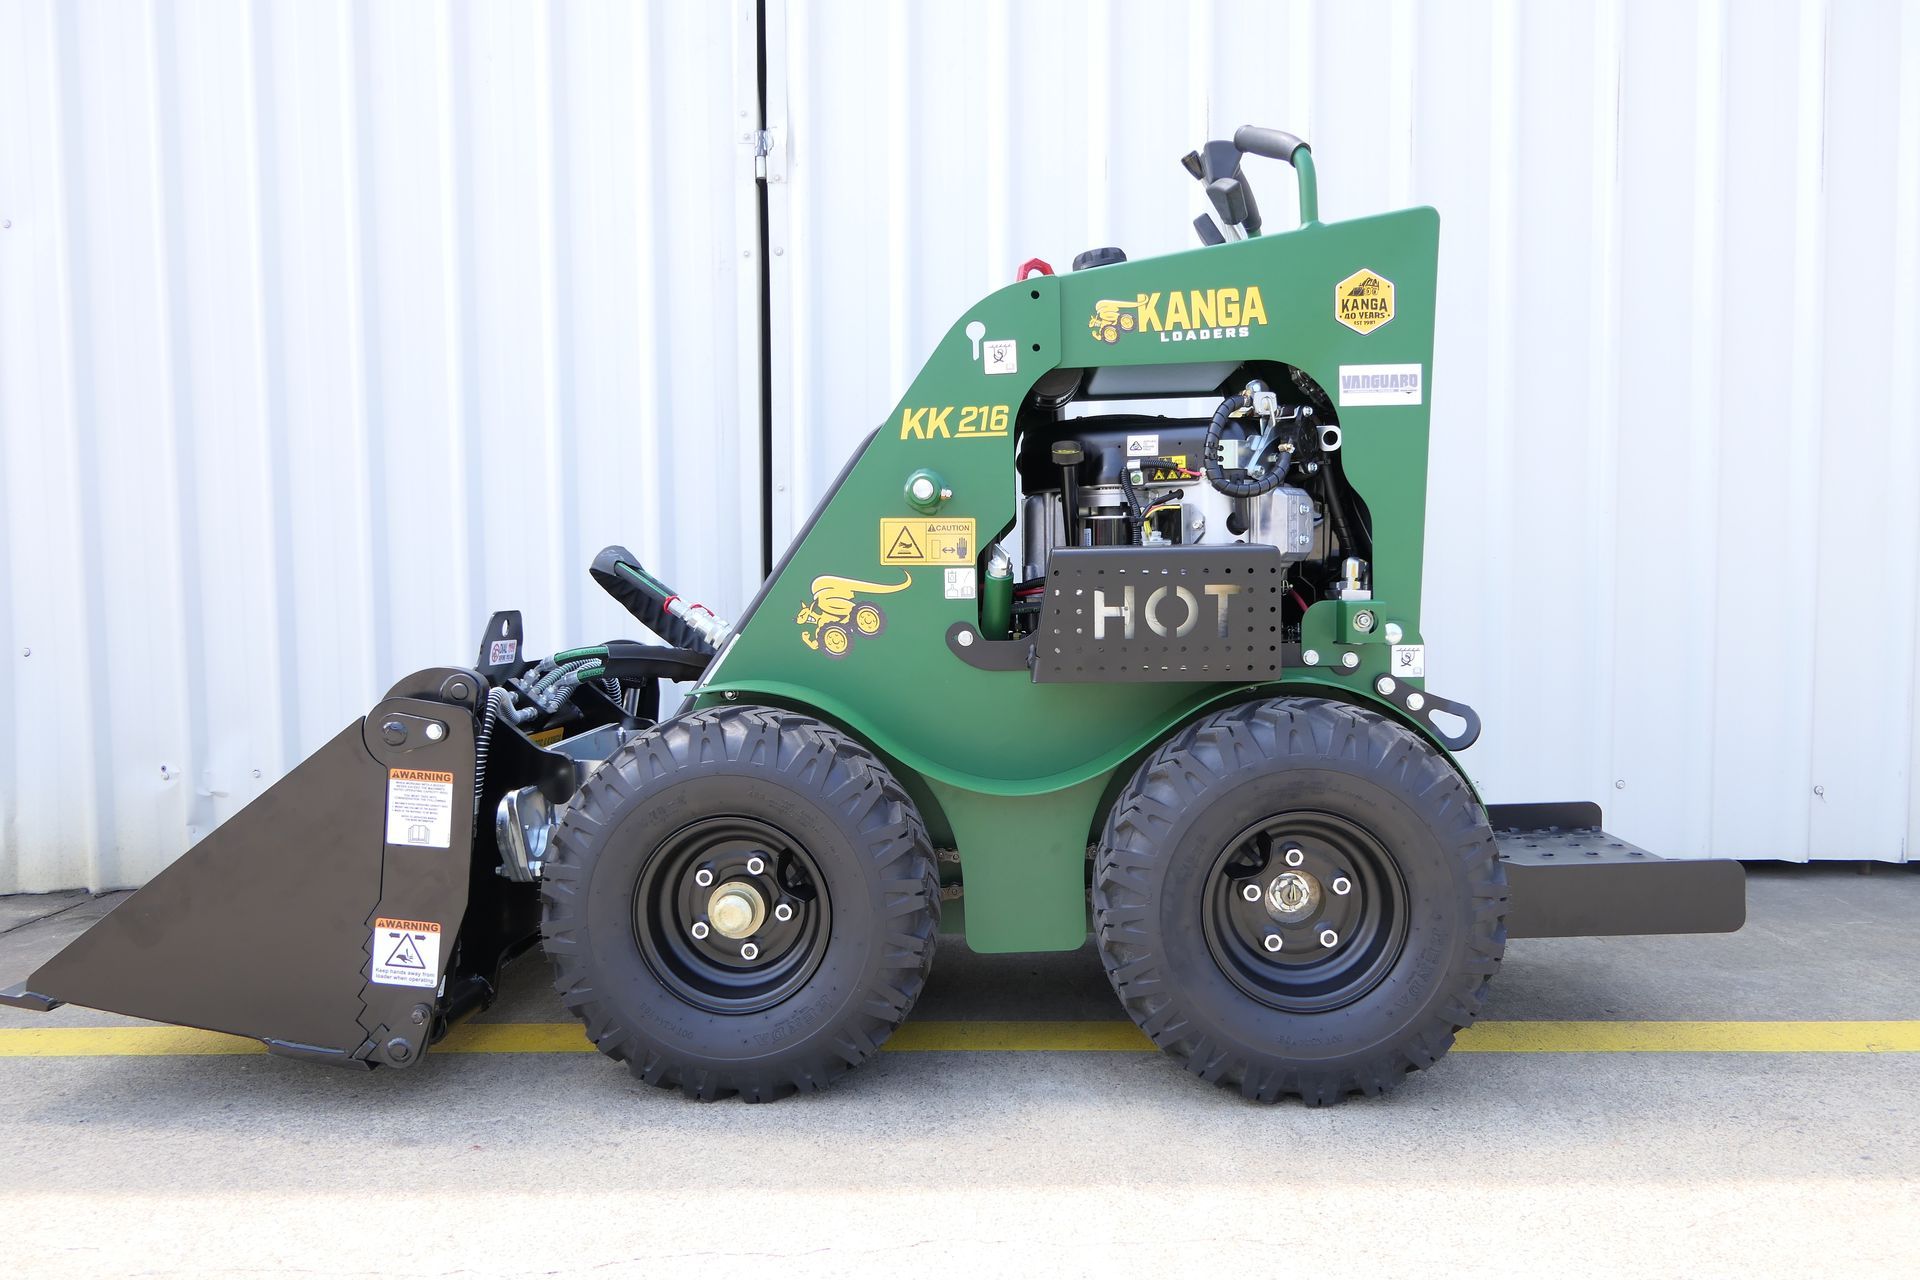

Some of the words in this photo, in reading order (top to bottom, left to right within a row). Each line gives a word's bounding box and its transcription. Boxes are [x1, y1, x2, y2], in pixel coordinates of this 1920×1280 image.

[1136, 286, 1268, 333] KANGA
[1341, 298, 1388, 313] KANGA
[1344, 312, 1357, 320] 40
[1358, 311, 1386, 320] YEARS
[1160, 327, 1250, 342] LOADERS
[1341, 374, 1418, 389] VANGUARD
[900, 406, 955, 440] KK
[958, 405, 1009, 432] 216
[1094, 584, 1243, 640] HOT
[399, 770, 452, 782] WARNING
[385, 920, 439, 932] WARNING
